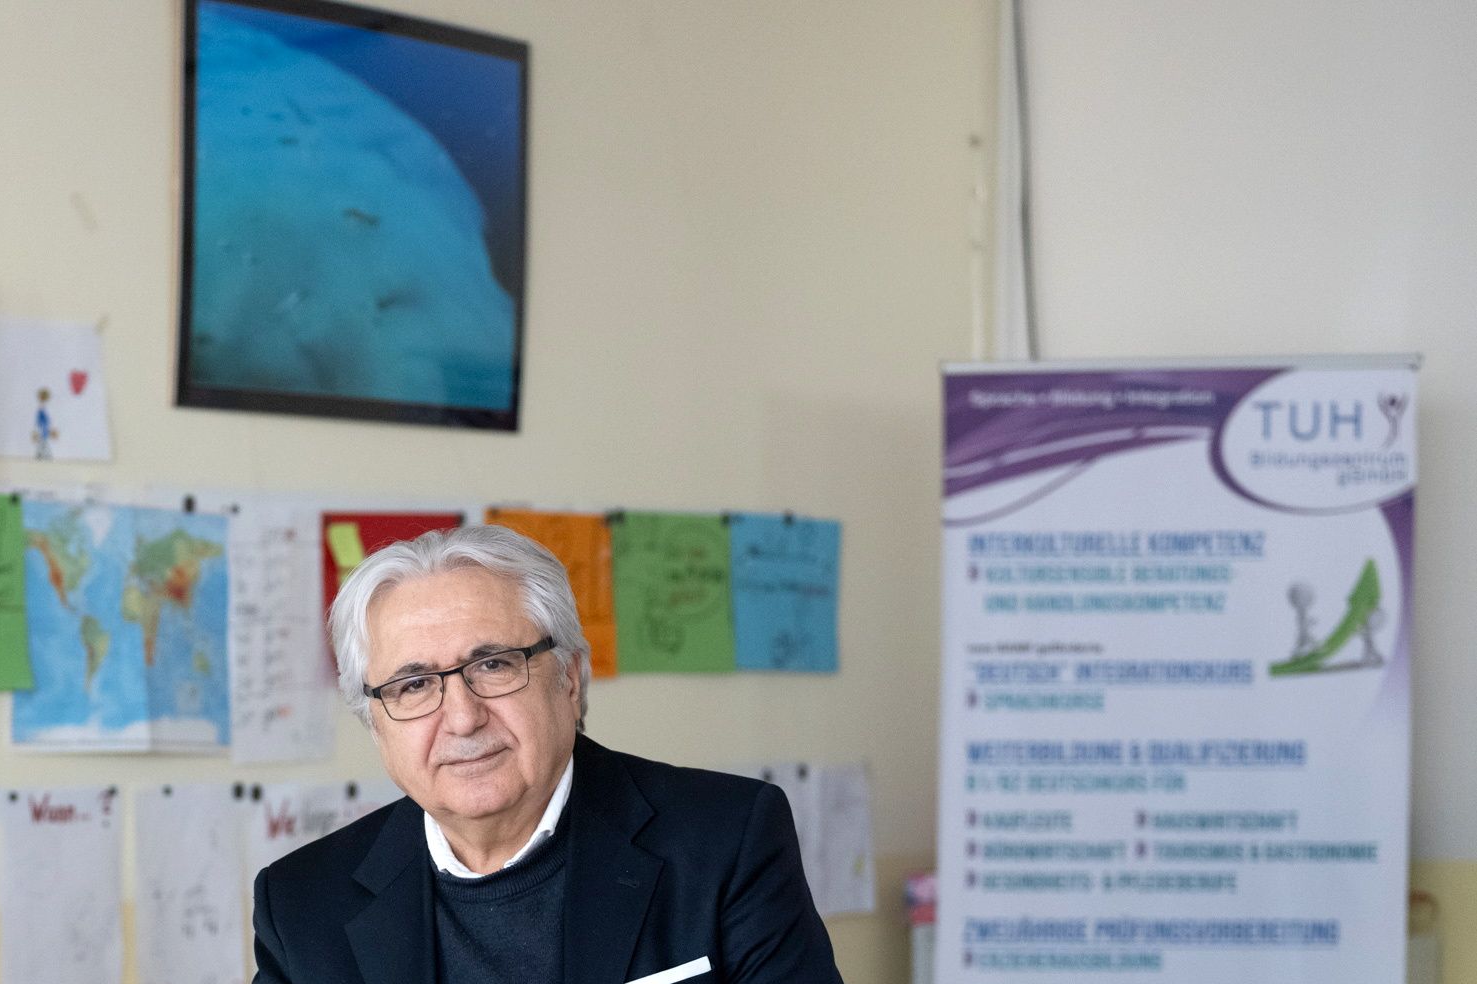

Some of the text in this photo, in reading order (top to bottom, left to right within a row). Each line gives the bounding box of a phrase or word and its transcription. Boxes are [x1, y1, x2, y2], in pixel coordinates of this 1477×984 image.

[1253, 401, 1362, 440] TUH
[970, 531, 1265, 555] INTERKULTURELLE KOMPETENZ
[1025, 593, 1226, 612] HANDLUNGSKOMPETENZ
[1076, 660, 1254, 683] INTEGRATIONSKURS
[966, 741, 1122, 764] WEITERBILDUNG
[1148, 741, 1307, 765] QUALIFIZIERUNG
[1094, 918, 1340, 943] PRÜFUNGSVORBEREITUNG
